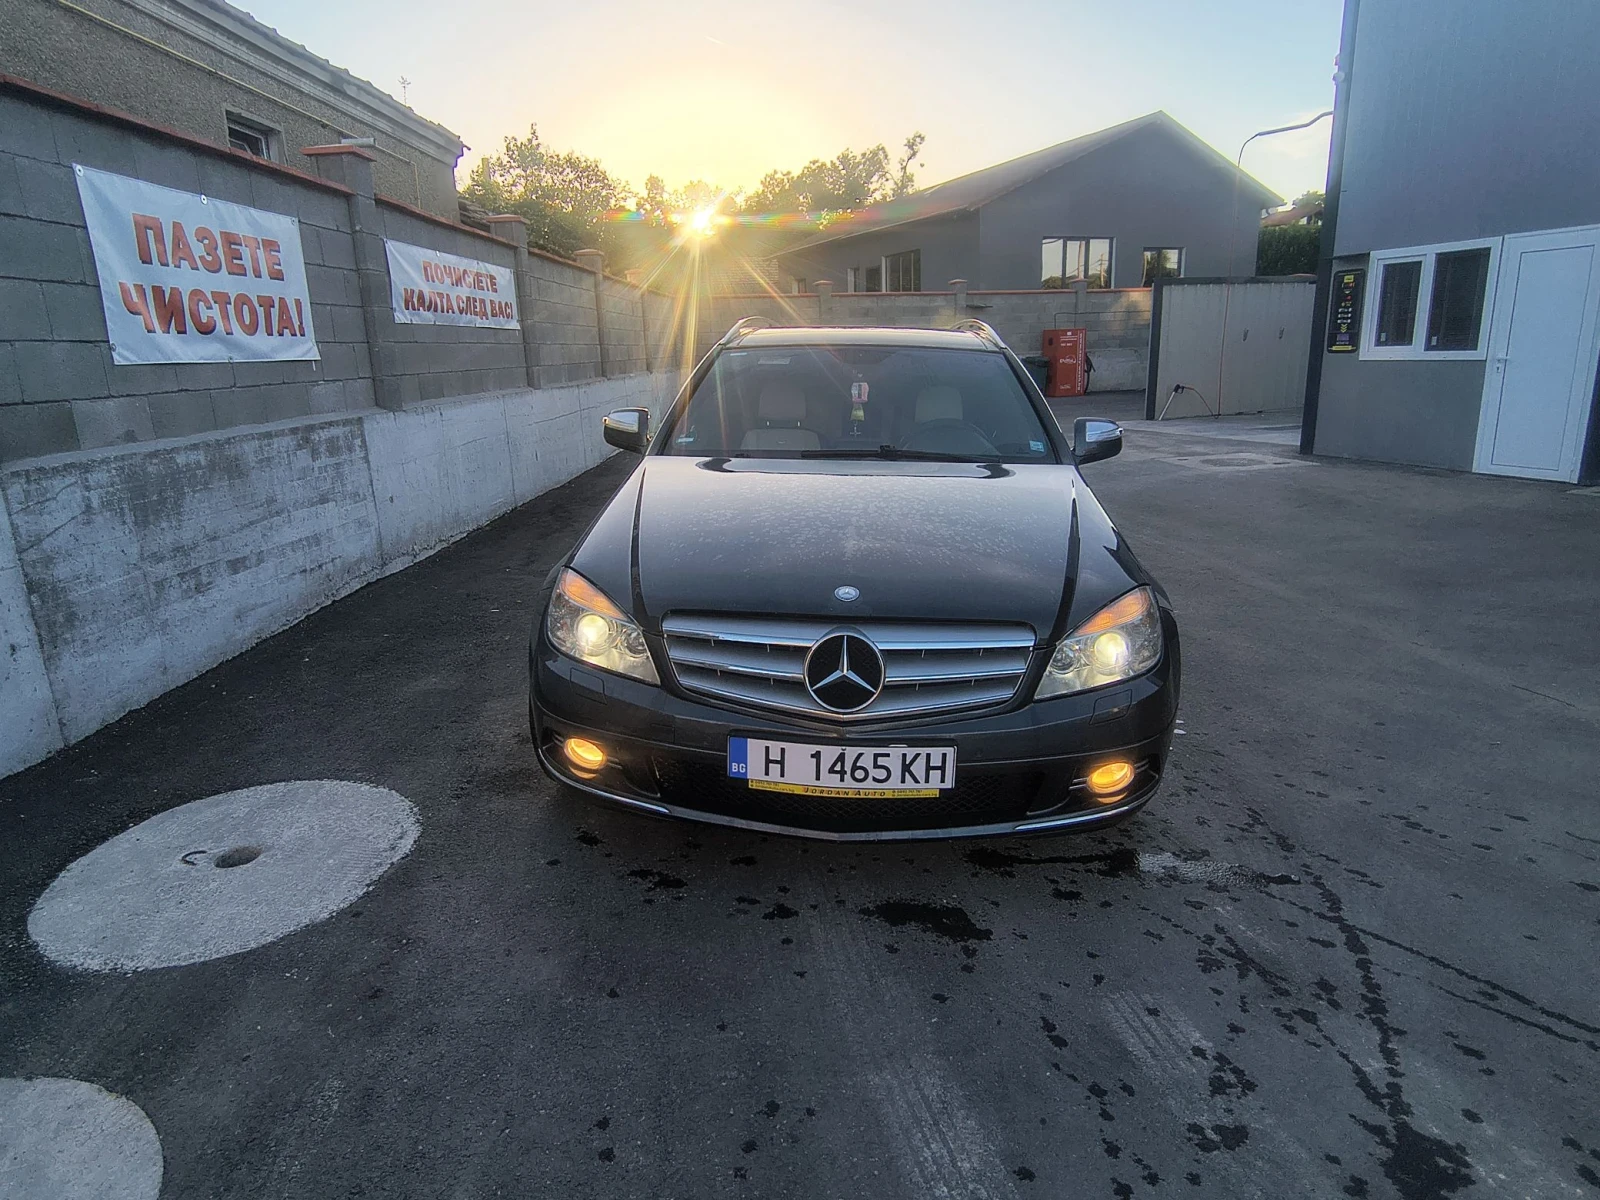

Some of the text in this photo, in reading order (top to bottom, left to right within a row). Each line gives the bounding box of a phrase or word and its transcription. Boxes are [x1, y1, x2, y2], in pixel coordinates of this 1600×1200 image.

[132, 212, 285, 281] ПАЗЕТЕ
[422, 260, 498, 293] ПОЧИСТЕТЕ
[118, 281, 306, 337] ЧИСТОТА!
[403, 287, 514, 320] КАЛТА СЛЕД ВАС!
[731, 763, 746, 773] BG
[764, 745, 786, 778] H
[804, 787, 850, 796] JORDAN
[854, 789, 886, 797] AUTO
